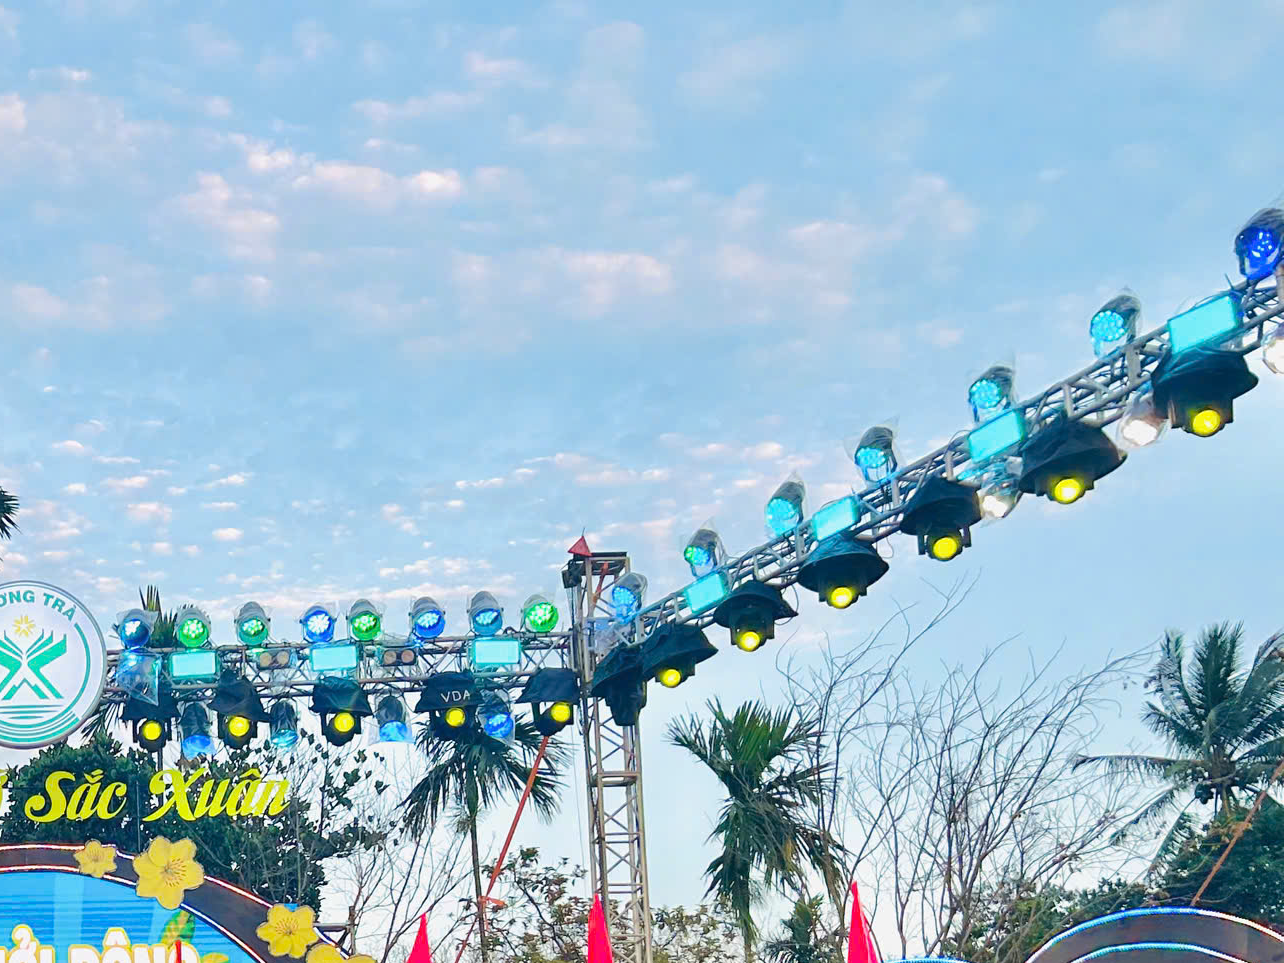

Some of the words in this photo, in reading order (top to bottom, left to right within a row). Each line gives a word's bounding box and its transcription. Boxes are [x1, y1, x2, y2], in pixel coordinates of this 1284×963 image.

[43, 592, 77, 621] TRÀ
[440, 689, 471, 703] VDA
[24, 768, 127, 823] Sắc
[142, 767, 290, 822] Xuân
